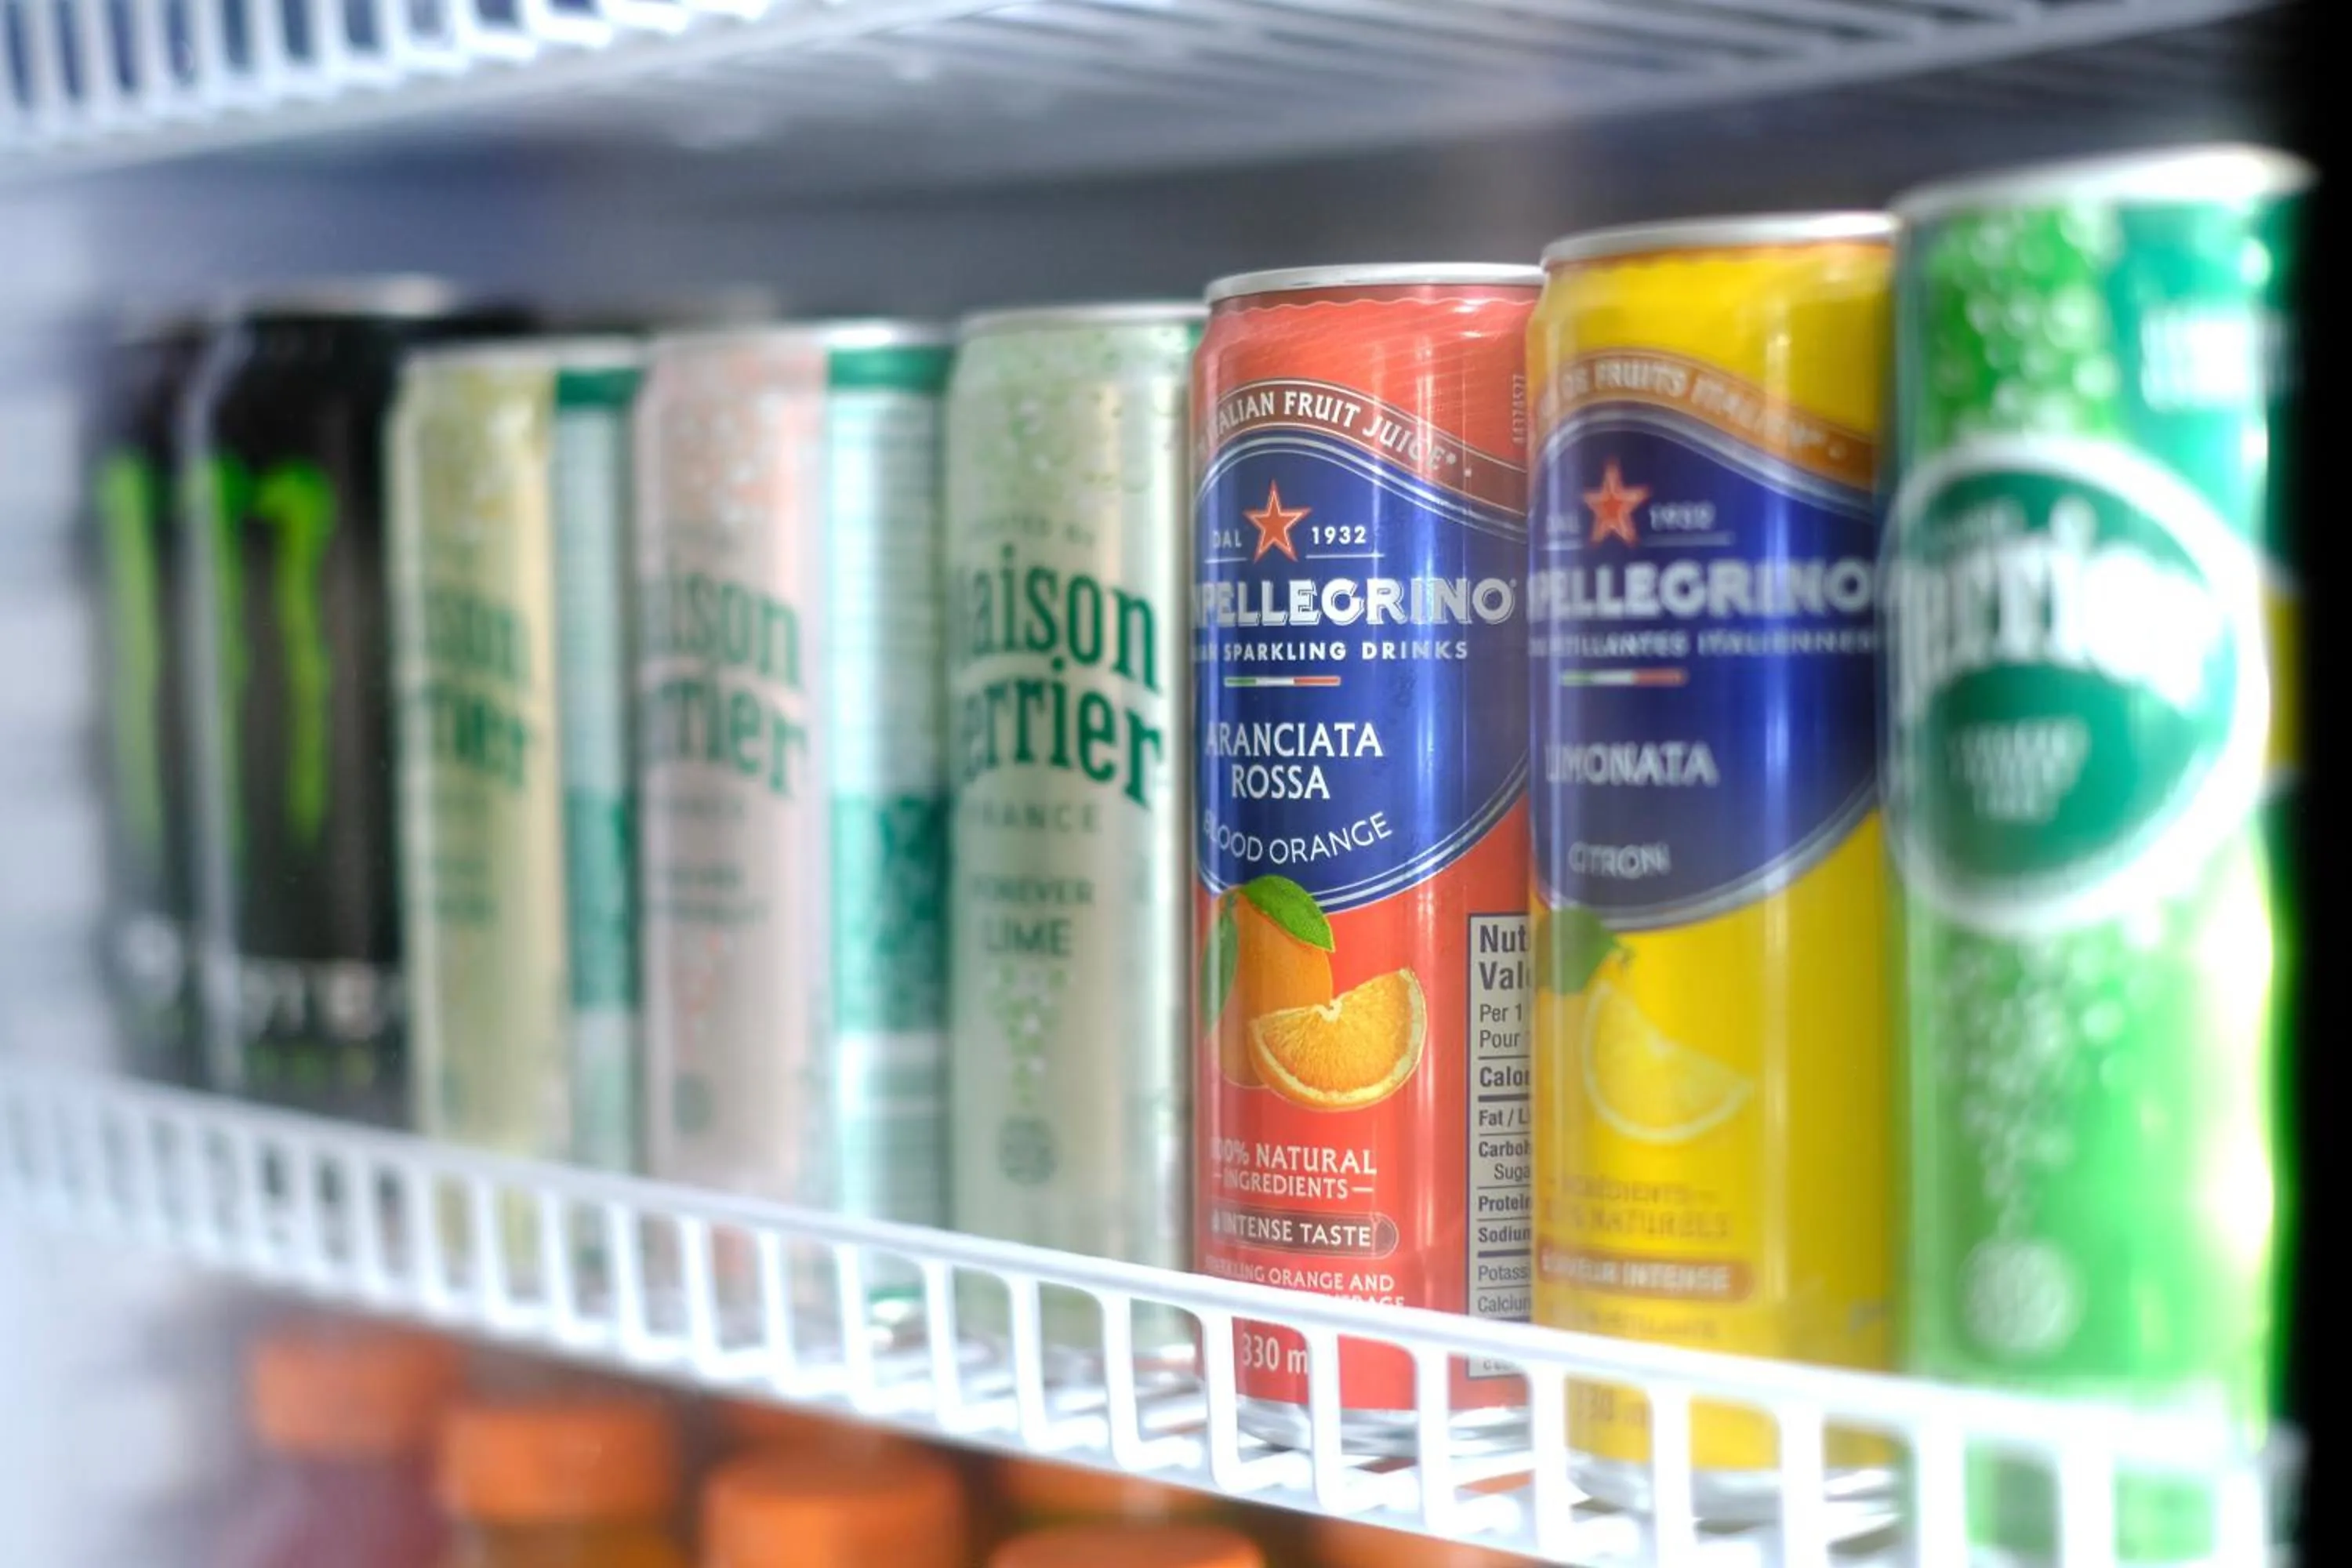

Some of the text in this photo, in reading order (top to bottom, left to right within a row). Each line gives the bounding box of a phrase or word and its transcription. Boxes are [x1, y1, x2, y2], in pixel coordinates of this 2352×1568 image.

[1283, 390, 1361, 428] FRUIT
[1212, 524, 1367, 549] DAL 1932
[1223, 641, 1346, 662] SPARKLING
[1362, 641, 1468, 661] DRINKS
[958, 655, 1163, 811] errier
[1204, 721, 1385, 758] ARANCIATA
[1231, 764, 1330, 800] ROSSA
[1203, 808, 1394, 865] BLOOD ORANGE
[1479, 1004, 1508, 1023] Per
[1479, 1029, 1520, 1049] Pour
[1479, 1109, 1503, 1127] Fat
[1254, 1142, 1377, 1175] NATURAL
[1222, 1167, 1348, 1200] INGREDIENTS
[1221, 1210, 1372, 1247] INTENSE TASTE
[1269, 1266, 1344, 1292] ORANGE
[1348, 1272, 1396, 1294] AND
[1241, 1331, 1280, 1372] 330
